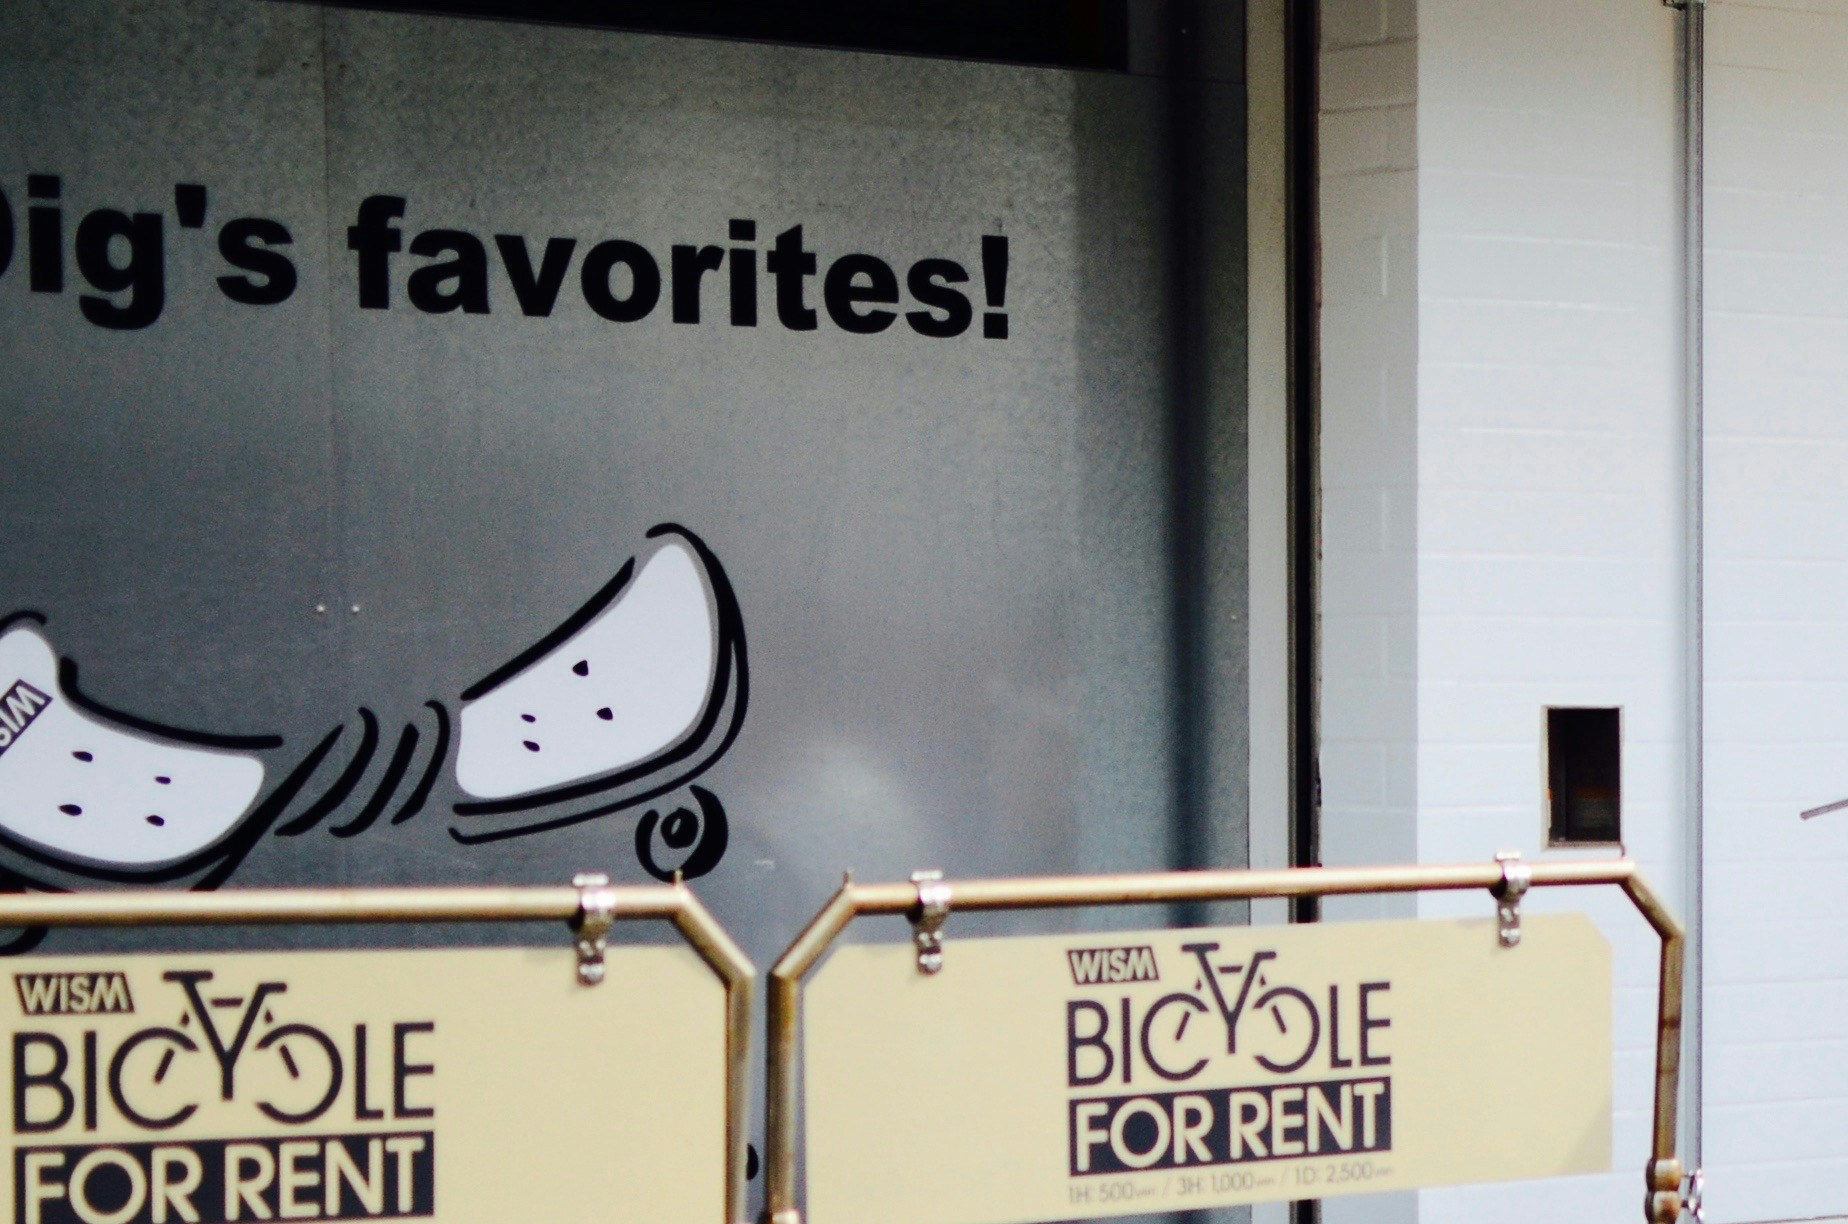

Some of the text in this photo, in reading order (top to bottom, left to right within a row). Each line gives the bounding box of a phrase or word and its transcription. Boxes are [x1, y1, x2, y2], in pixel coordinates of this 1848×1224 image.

[0, 175, 1010, 340] ig's favorites!
[19, 974, 131, 1015] WISM
[1069, 946, 1159, 983] WISM
[12, 970, 435, 1134] BICYCLE
[1066, 942, 1392, 1088] BICYCLE
[1075, 1082, 1386, 1173] FOR RENT
[224, 1137, 425, 1222] RENT
